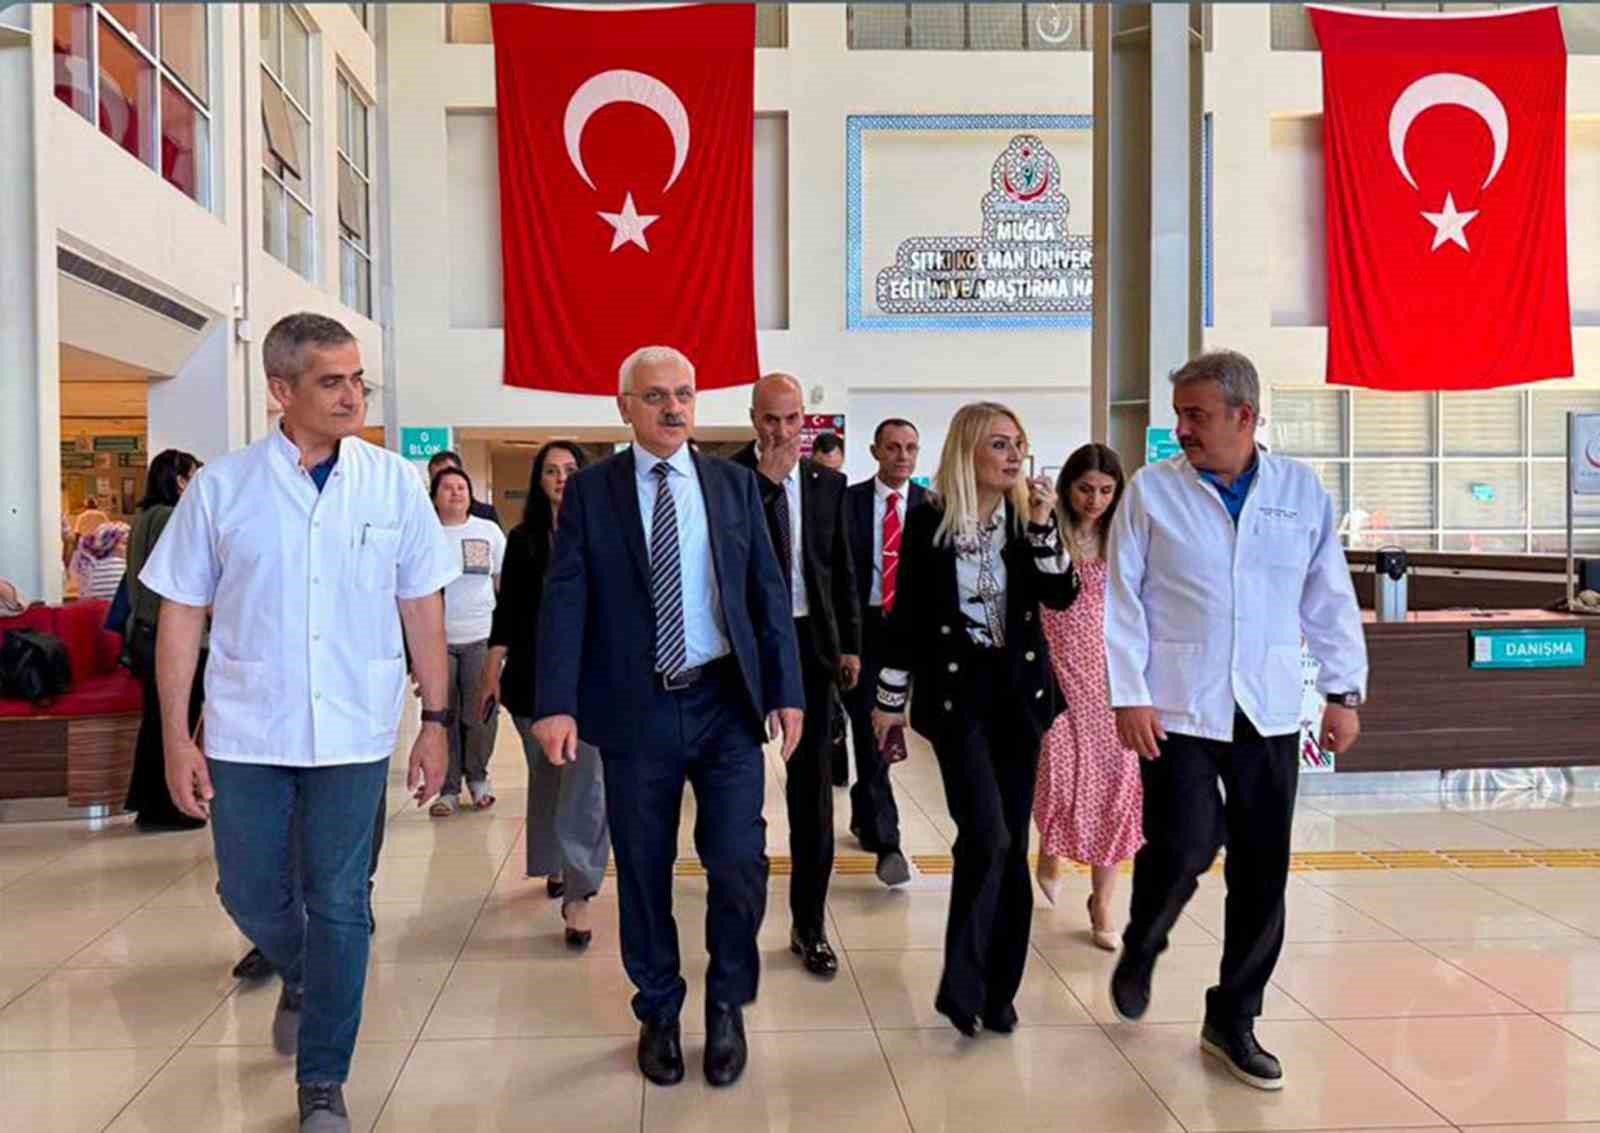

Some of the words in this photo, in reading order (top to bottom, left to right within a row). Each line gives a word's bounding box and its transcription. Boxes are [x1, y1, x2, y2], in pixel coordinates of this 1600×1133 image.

[996, 219, 1055, 241] MUĞLA
[949, 278, 973, 299] VE
[974, 278, 1069, 301] ARAŞTIRMA
